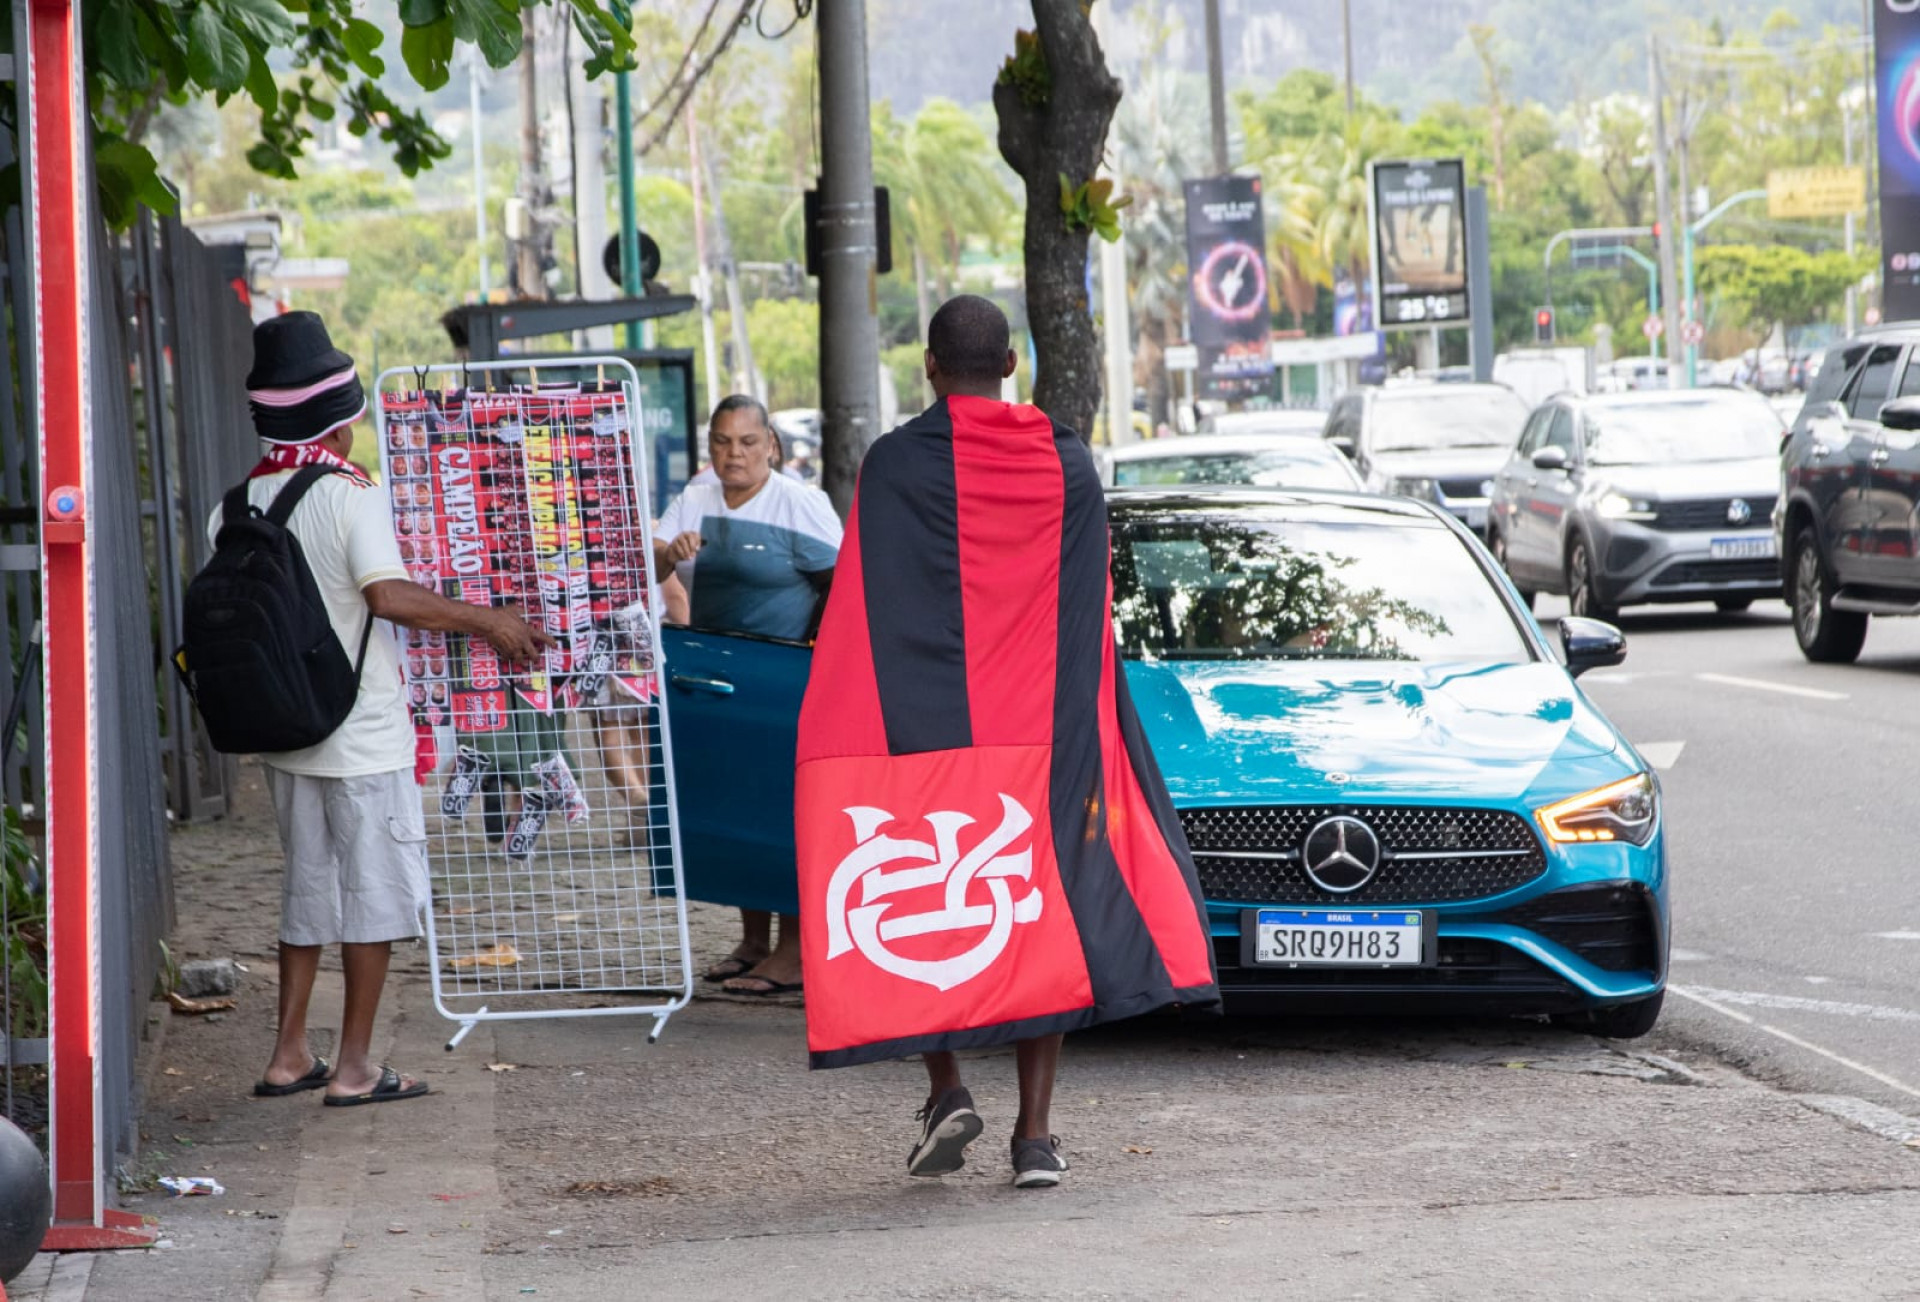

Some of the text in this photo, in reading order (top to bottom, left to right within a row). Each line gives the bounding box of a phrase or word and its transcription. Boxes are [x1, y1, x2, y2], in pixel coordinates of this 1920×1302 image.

[437, 446, 485, 573] CAMPEÃO
[1327, 914, 1353, 923] BRASIL
[1273, 929, 1401, 959] SRQ9H83
